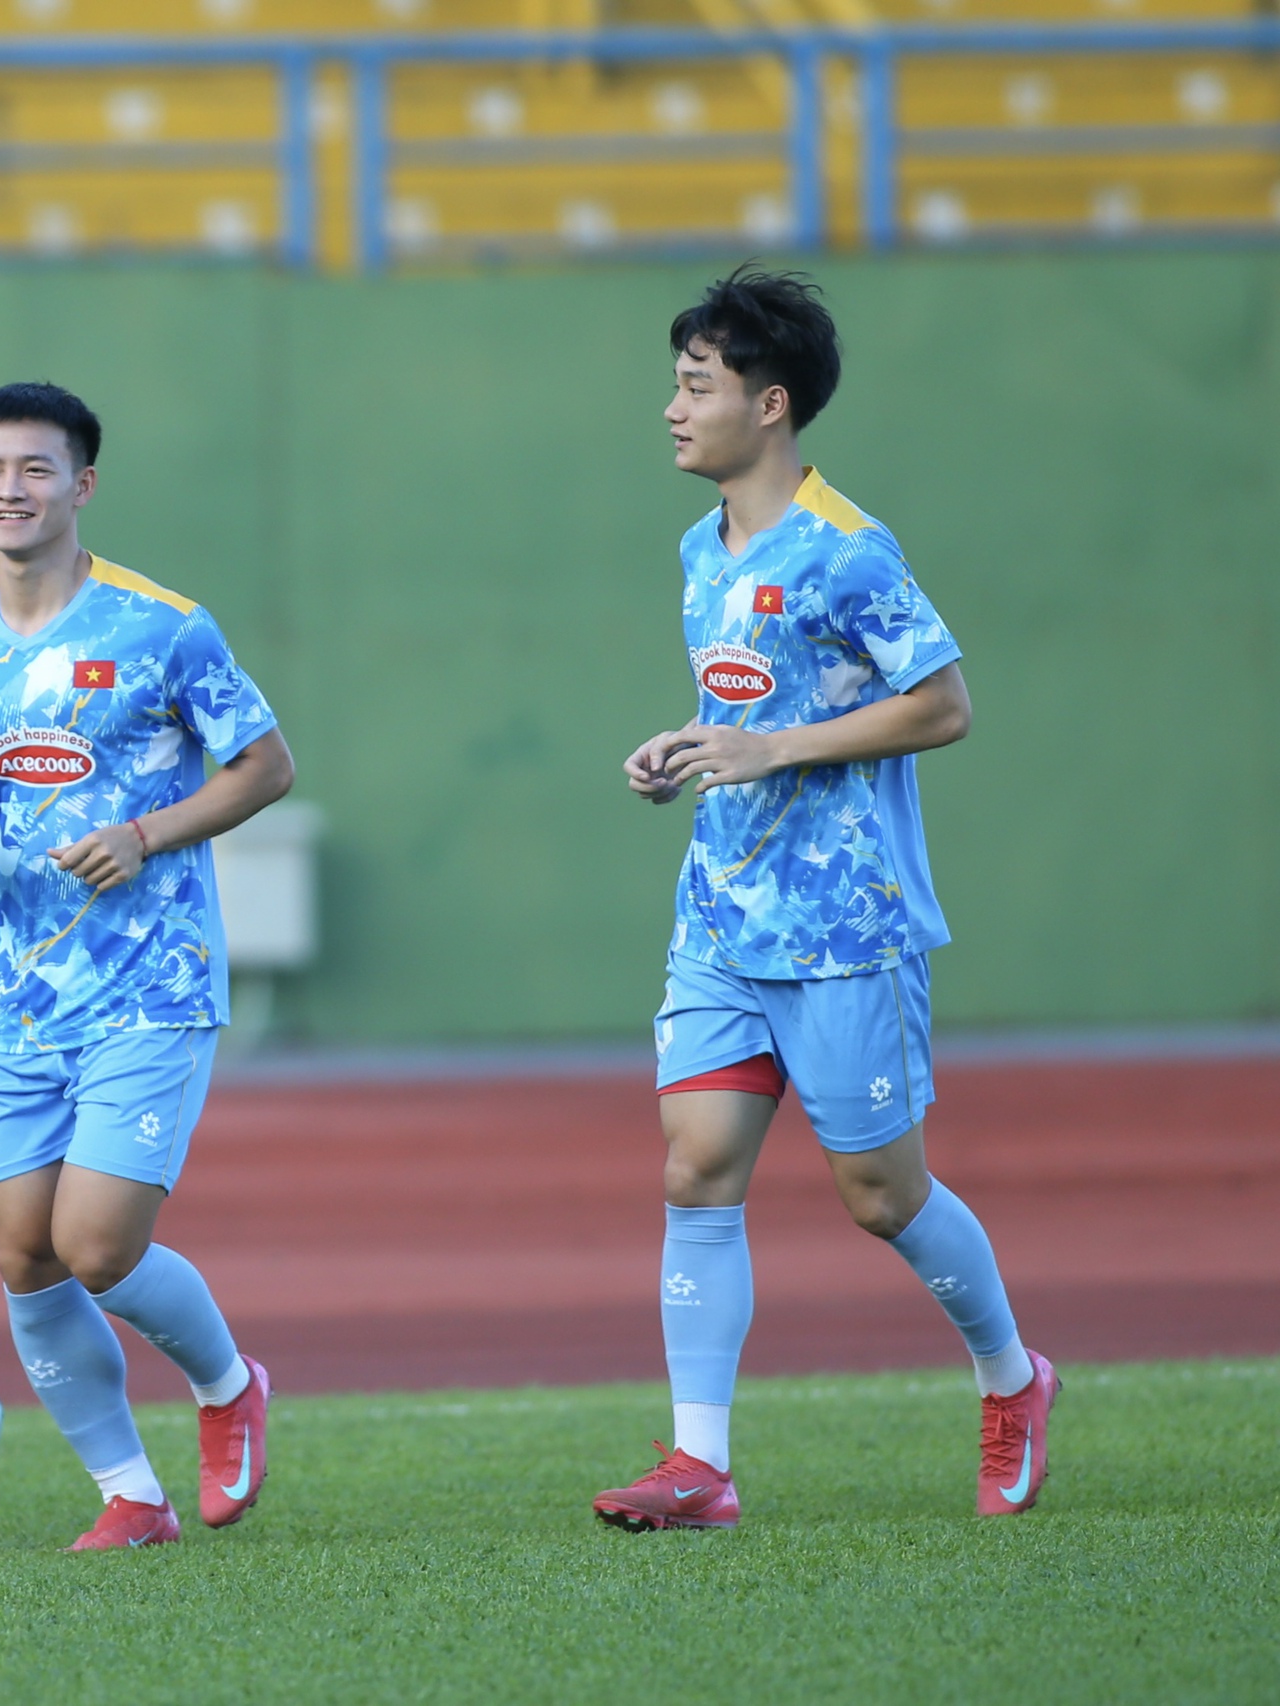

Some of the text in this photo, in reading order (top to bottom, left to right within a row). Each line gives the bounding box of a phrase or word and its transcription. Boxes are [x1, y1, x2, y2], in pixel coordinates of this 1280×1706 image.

[700, 642, 770, 669] Cook happiness
[23, 728, 92, 750] happiness
